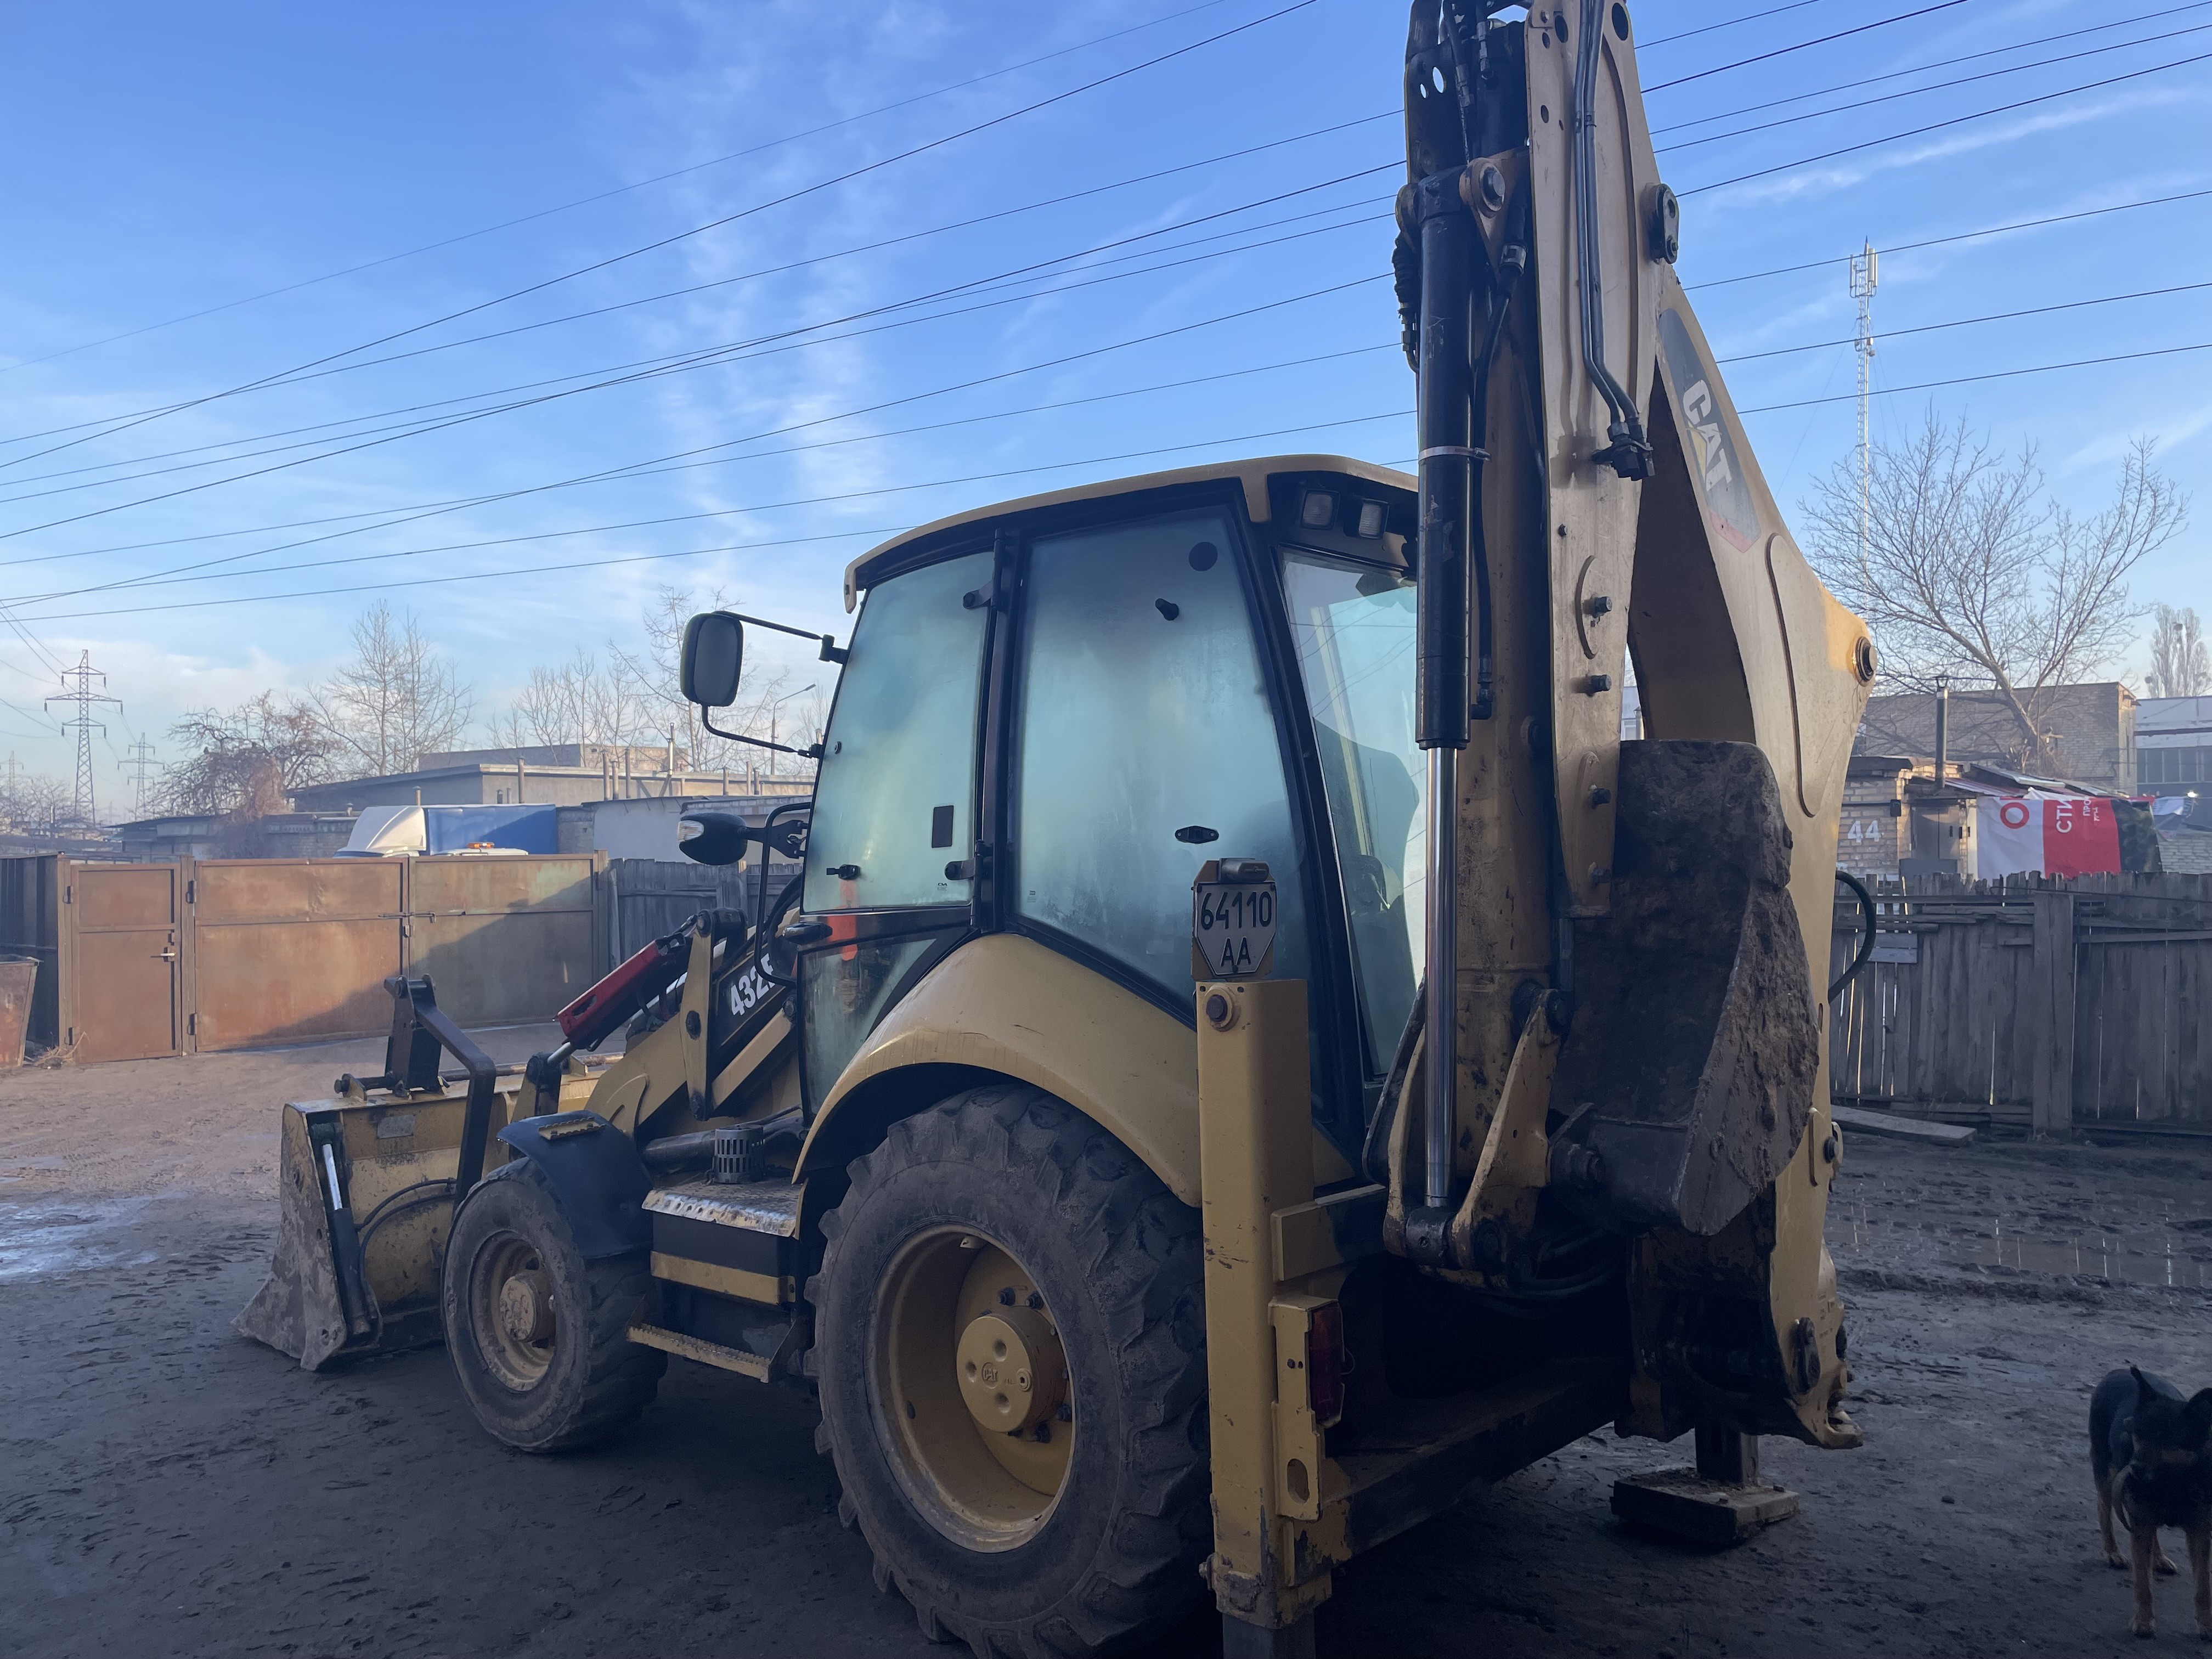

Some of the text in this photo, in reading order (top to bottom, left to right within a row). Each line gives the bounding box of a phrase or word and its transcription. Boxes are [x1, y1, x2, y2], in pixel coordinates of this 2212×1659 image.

[1683, 379, 1732, 492] CAT
[1847, 820, 1882, 843] 44
[1200, 891, 1272, 930] 64110
[1220, 936, 1251, 967] AA
